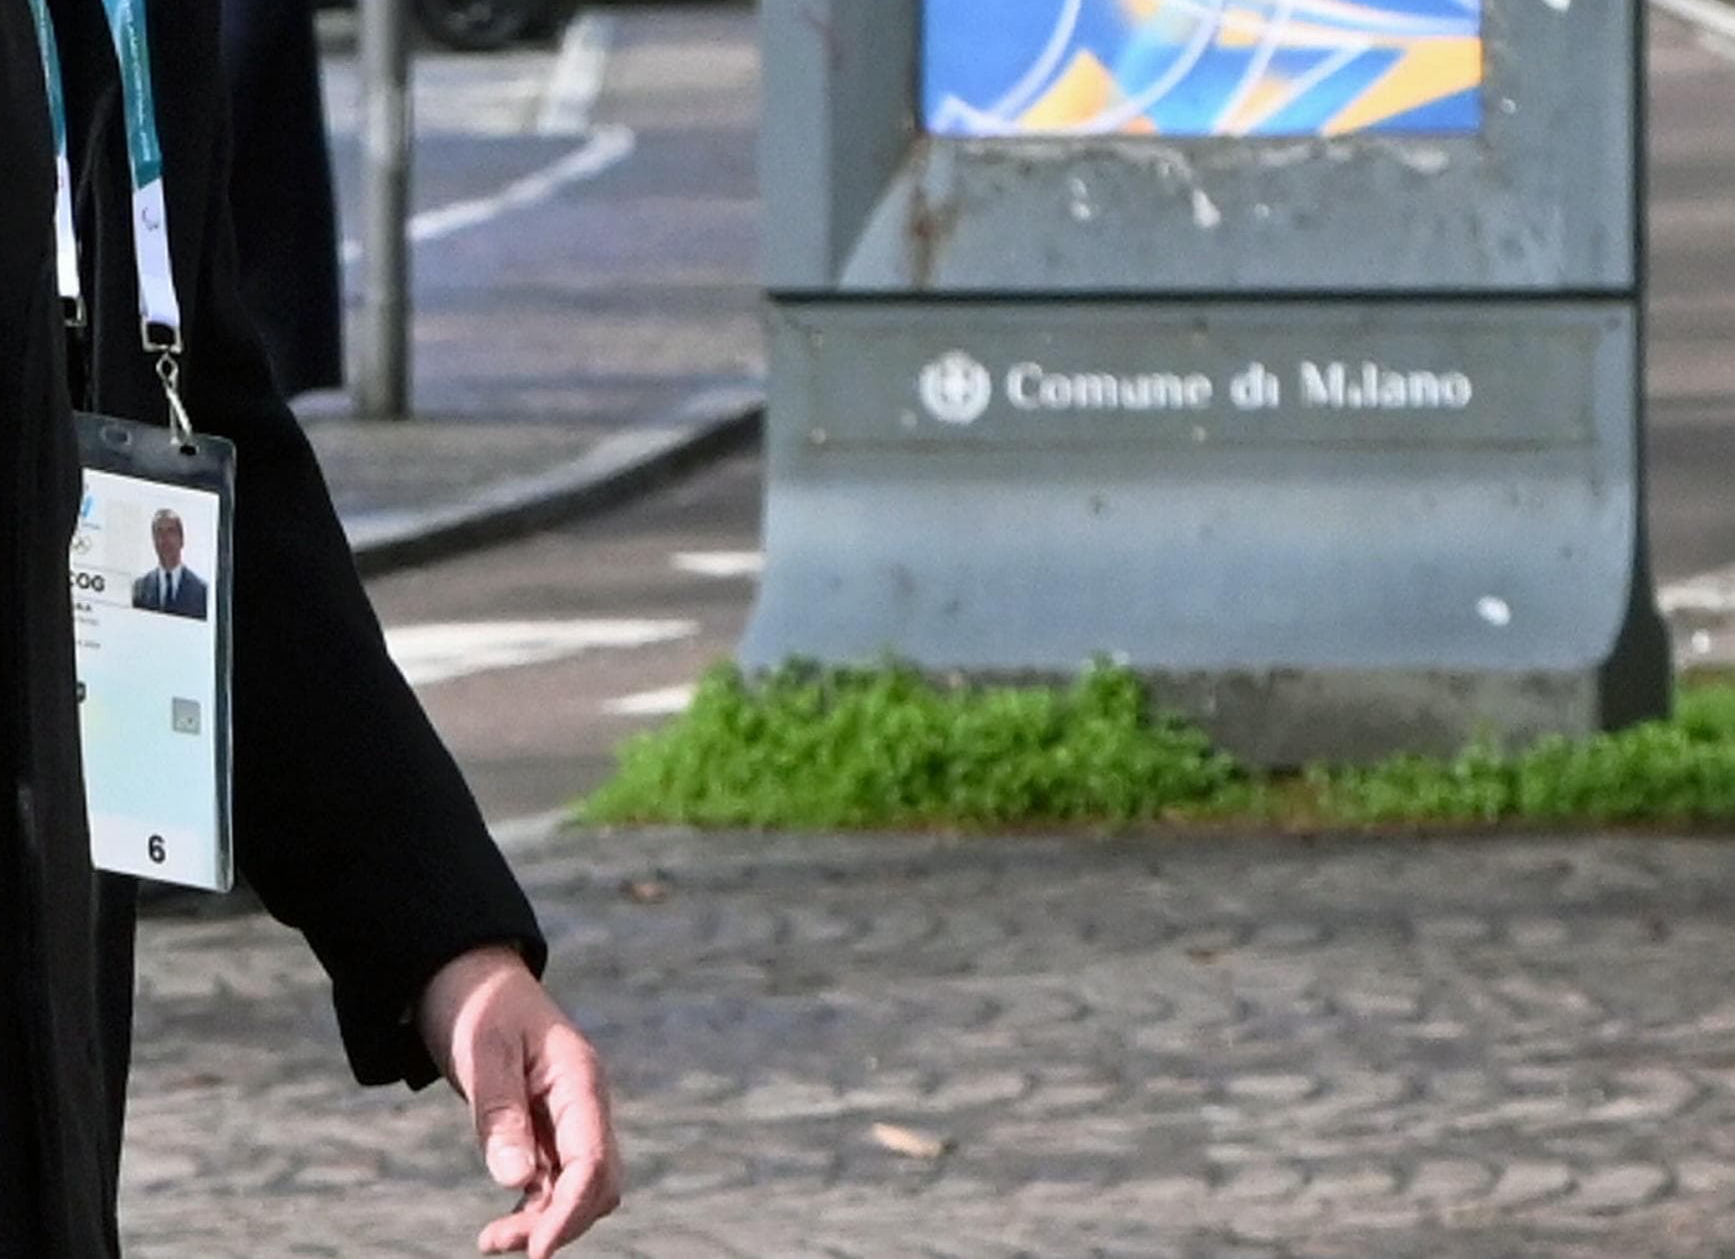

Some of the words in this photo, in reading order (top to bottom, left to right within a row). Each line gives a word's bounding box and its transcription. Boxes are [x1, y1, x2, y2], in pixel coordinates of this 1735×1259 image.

[1007, 360, 1213, 410] Comune
[1230, 361, 1279, 410] di
[1300, 360, 1473, 409] Milano
[148, 834, 166, 864] 6
